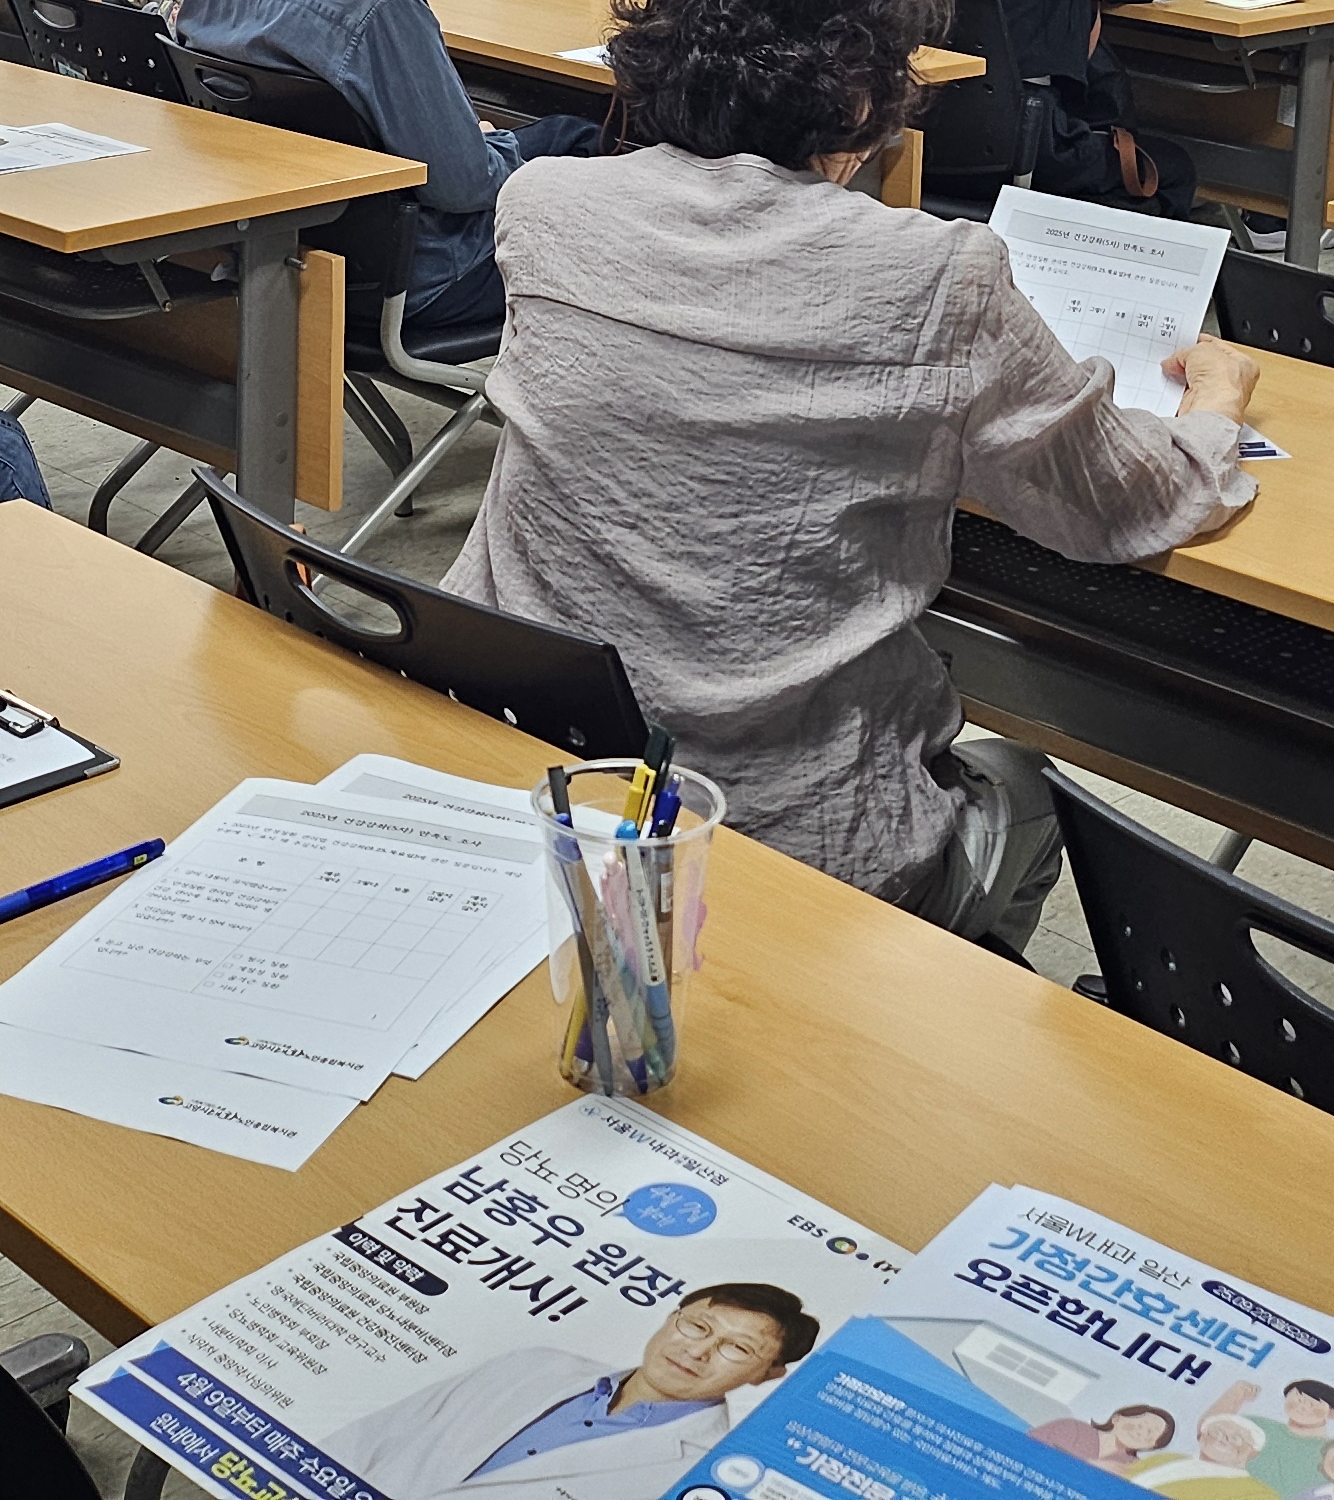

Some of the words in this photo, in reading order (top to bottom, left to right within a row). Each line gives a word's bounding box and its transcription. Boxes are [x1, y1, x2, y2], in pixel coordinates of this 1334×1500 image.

[499, 1139, 630, 1218] 당뇨명의
[348, 1231, 382, 1256] 이력
[373, 1249, 398, 1267] 및
[384, 1196, 589, 1323] 진료개시!
[442, 1164, 585, 1250] 남홍우
[572, 1242, 687, 1308] 원장
[786, 1214, 829, 1239] EBS
[1020, 1206, 1137, 1266] 서울W내과
[1138, 1257, 1194, 1291] 일산
[292, 1272, 360, 1320] 국립중앙의료원
[312, 1262, 381, 1309] 국립중앙의료원
[375, 1303, 458, 1358] 당뇨내분비센터장
[332, 1250, 401, 1298] 국립중앙의료원
[397, 1292, 431, 1316] 부원장
[987, 1225, 1276, 1369] 가정간호센터
[187, 1332, 217, 1357] 식약처
[207, 1319, 260, 1356] 내분비학회
[255, 1351, 280, 1371] 이사
[228, 1308, 280, 1343] 당뇨병학회
[249, 1296, 301, 1331] 노인병학회
[298, 1327, 331, 1351] 부회장
[344, 1332, 387, 1364] 연구교수
[953, 1257, 1213, 1386] 오픈합니다!
[149, 1411, 221, 1464] 원내에서
[210, 1450, 301, 1500] 당뇨교
[176, 1371, 214, 1399] 4월
[203, 1389, 274, 1440] 9일부터
[263, 1427, 306, 1462] 매주
[298, 1454, 357, 1499] 수요일
